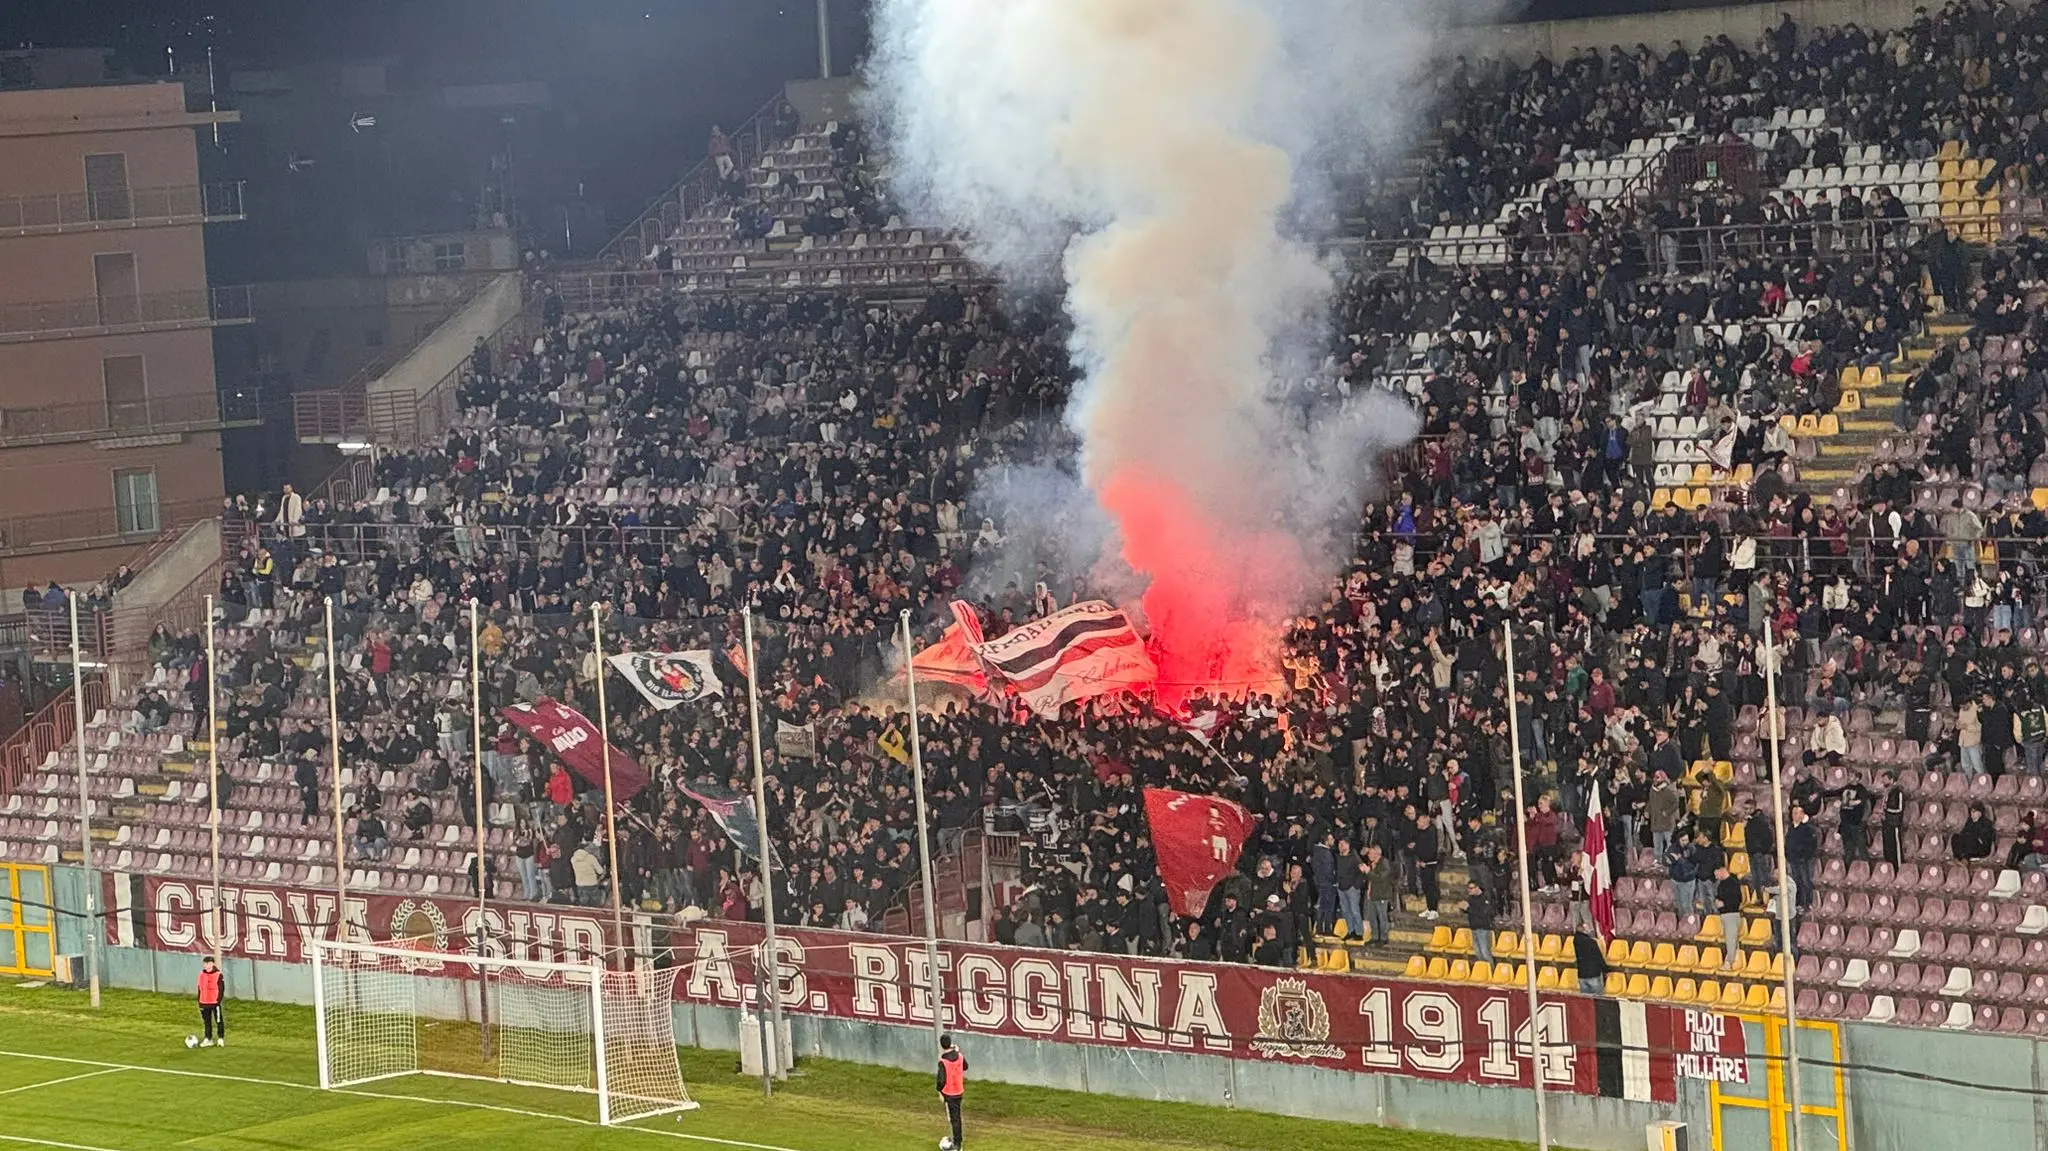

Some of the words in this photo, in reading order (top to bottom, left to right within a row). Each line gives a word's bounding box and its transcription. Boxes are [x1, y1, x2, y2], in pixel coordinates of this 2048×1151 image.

[156, 882, 380, 964] CURVA
[460, 906, 607, 984] SUD
[686, 928, 829, 1011] A.S.
[849, 942, 1232, 1051] REGGINA
[1359, 987, 1577, 1085] 1914
[1685, 1009, 1726, 1036] ALDO
[1676, 1053, 1746, 1084] MOLLARE
